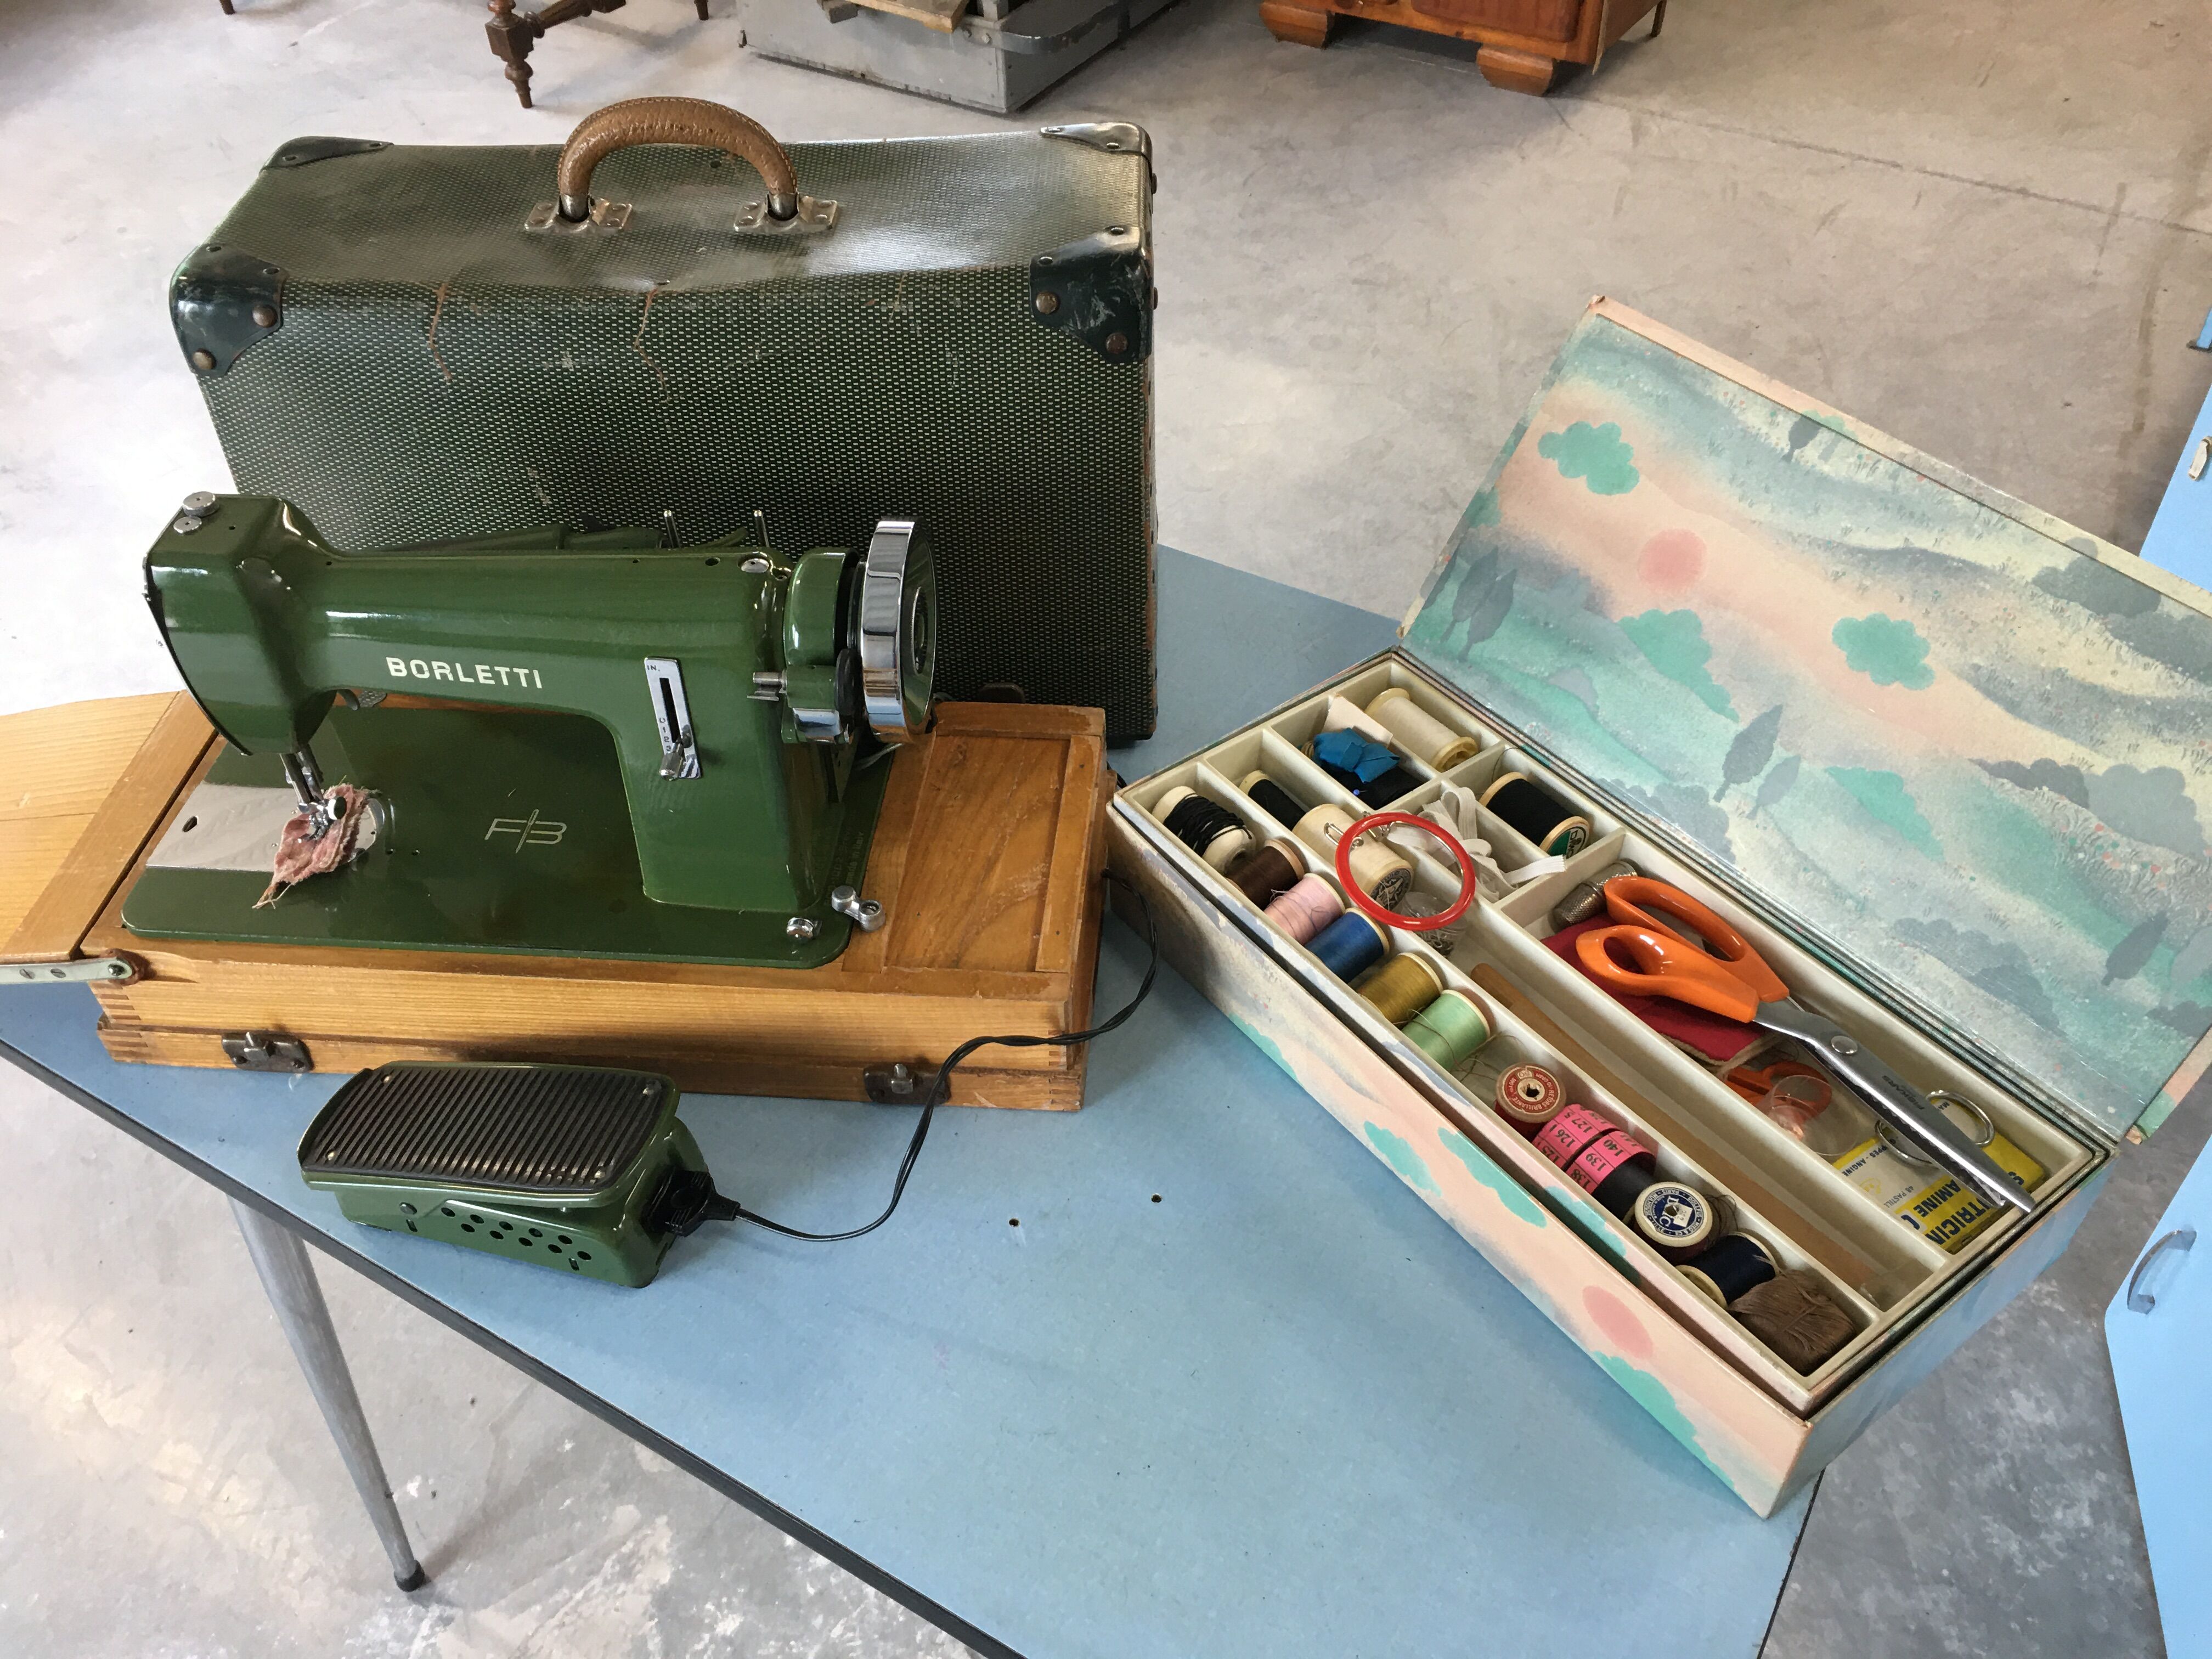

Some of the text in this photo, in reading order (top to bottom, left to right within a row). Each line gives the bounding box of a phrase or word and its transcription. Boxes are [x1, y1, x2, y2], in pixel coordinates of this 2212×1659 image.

[386, 657, 543, 689] BORLETTI
[1571, 1118, 1593, 1133] 127
[1555, 1129, 1575, 1148] 126
[1603, 1139, 1624, 1156] 140
[1585, 1153, 1606, 1172] 139
[1842, 1158, 1866, 1177] ANGINE
[1571, 1169, 1590, 1189] 138
[1883, 1191, 1906, 1208] PASTILL
